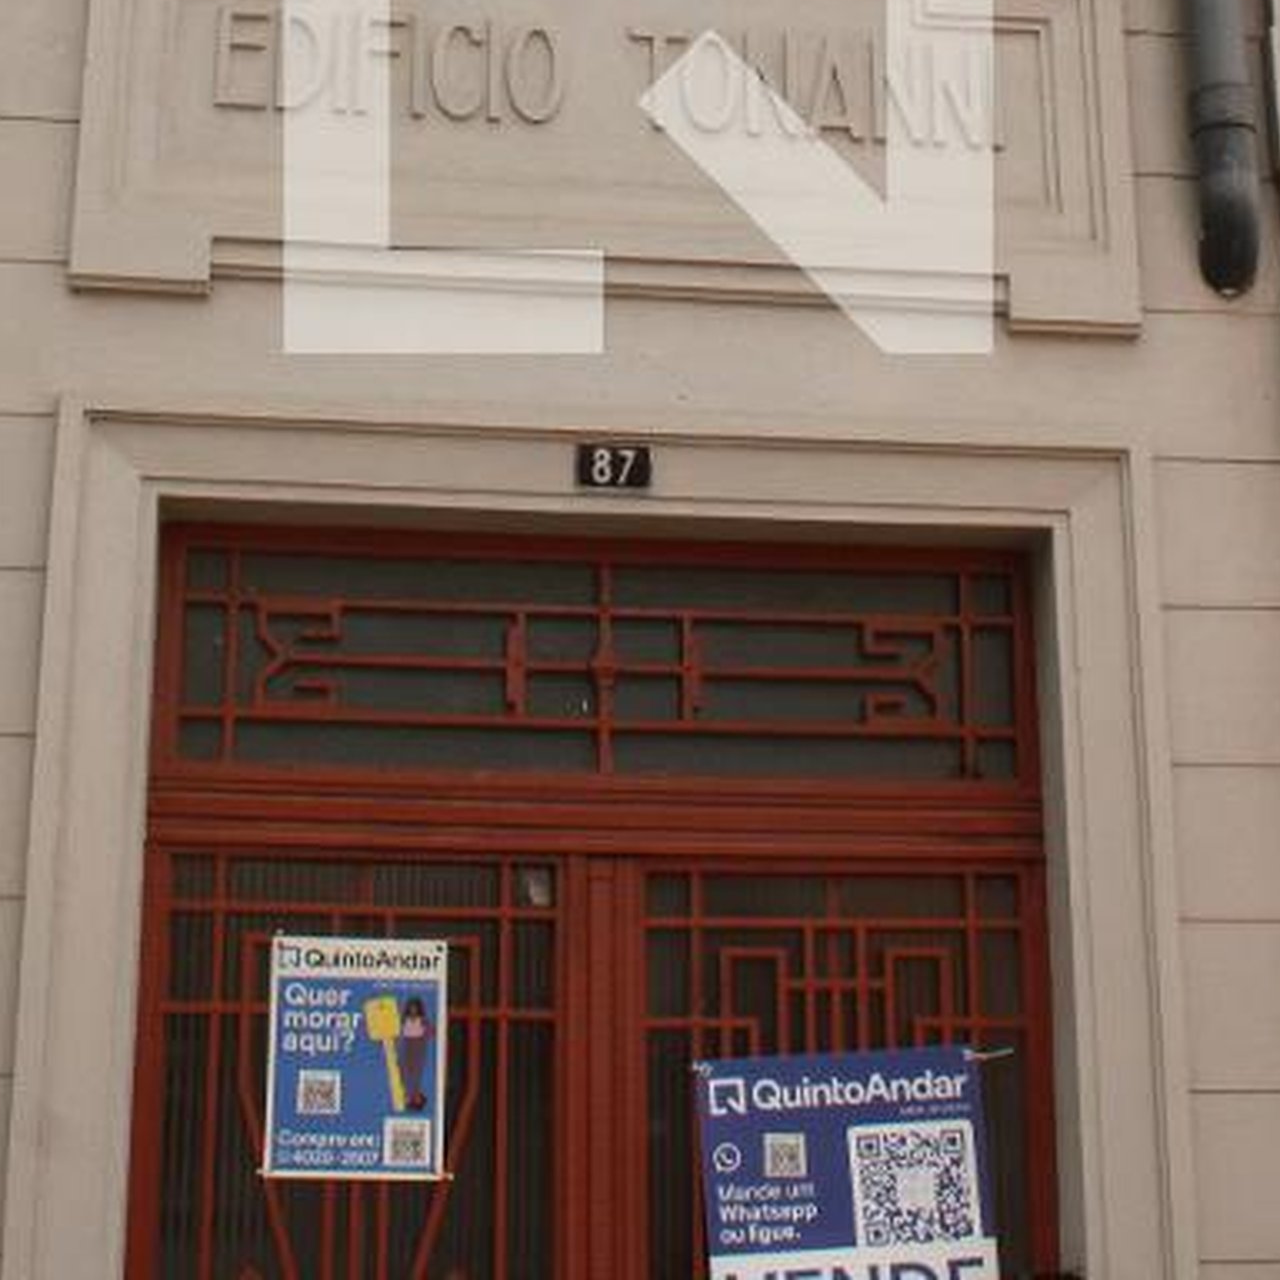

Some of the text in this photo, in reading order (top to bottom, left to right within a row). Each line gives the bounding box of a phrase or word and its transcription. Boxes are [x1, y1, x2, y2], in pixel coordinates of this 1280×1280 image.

[213, 5, 565, 125] EDIFICIO
[592, 448, 637, 485] 87
[304, 947, 442, 972] QuintoAndar
[284, 981, 352, 1007] Quer
[282, 1009, 363, 1029] morar
[281, 1030, 356, 1056] aqui?
[752, 1069, 968, 1111] QuintoAndar
